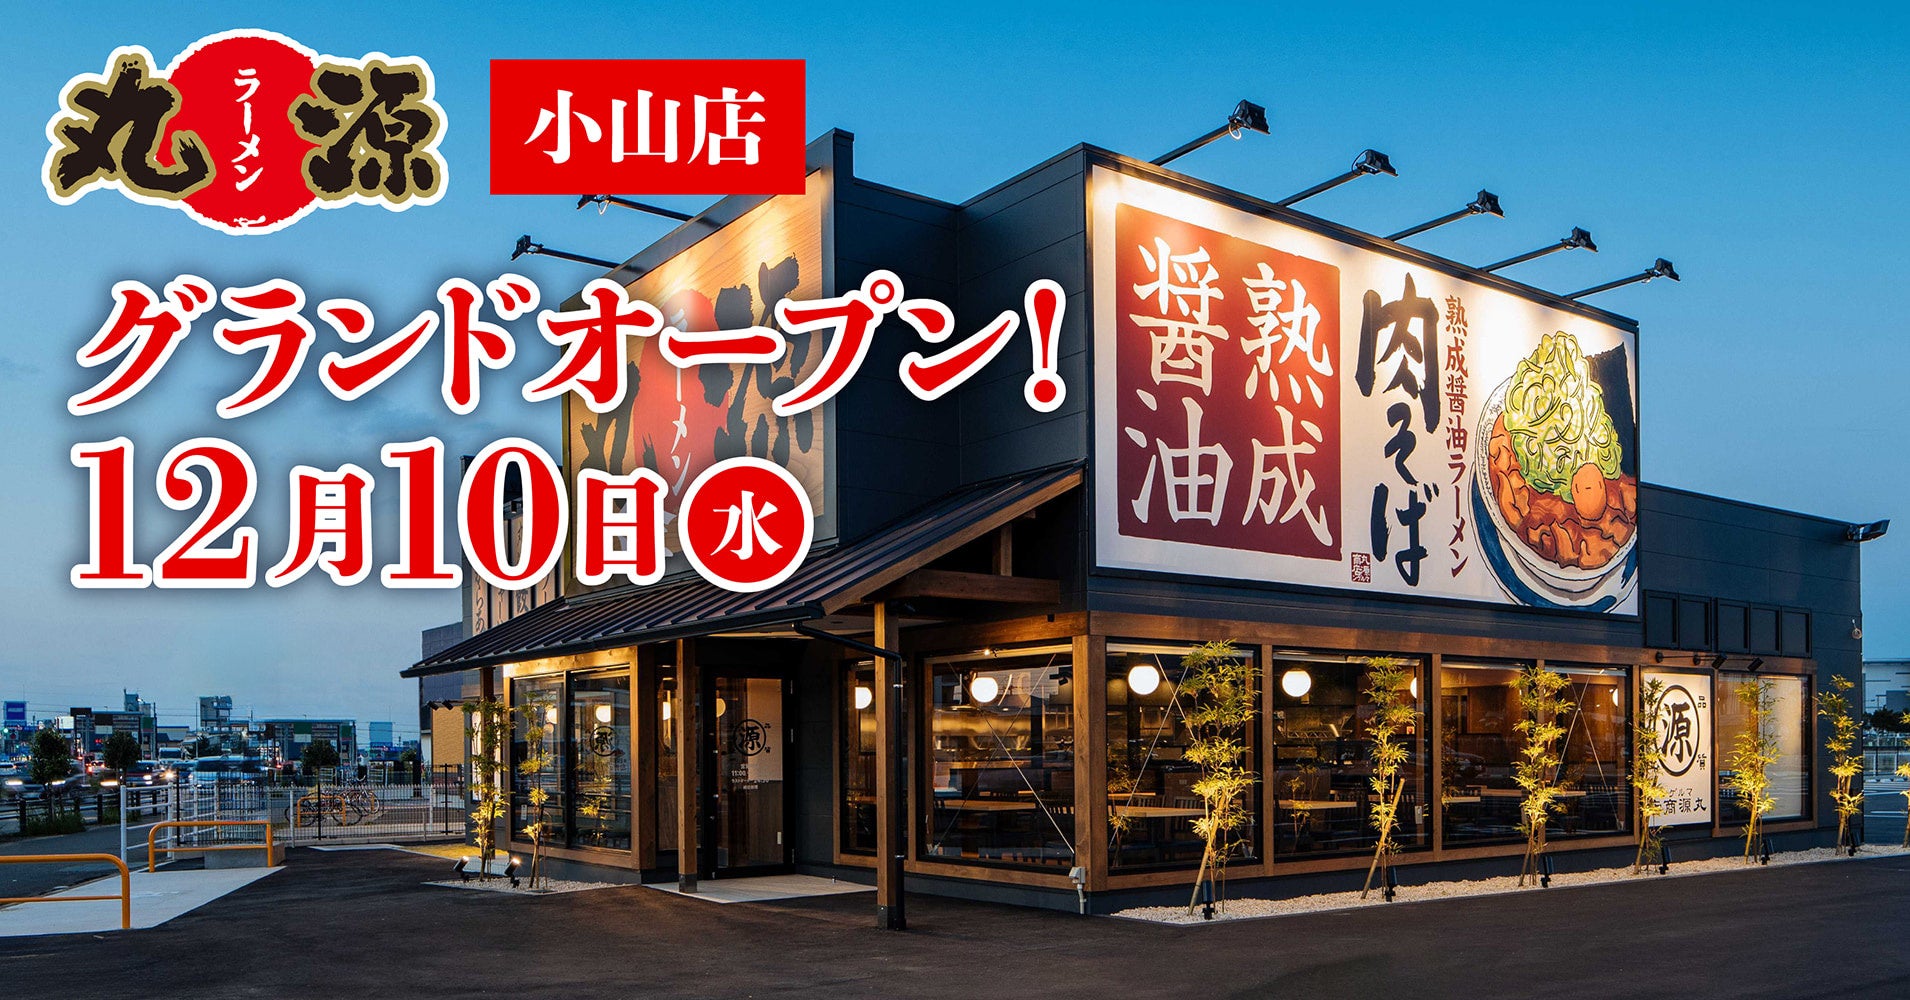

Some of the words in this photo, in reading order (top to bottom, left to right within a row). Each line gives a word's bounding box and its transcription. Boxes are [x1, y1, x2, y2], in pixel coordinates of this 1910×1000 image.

[1355, 272, 1441, 587] 肉そば
[1445, 295, 1469, 578] 熟成醤油ラーメン
[1662, 701, 1693, 764] 源
